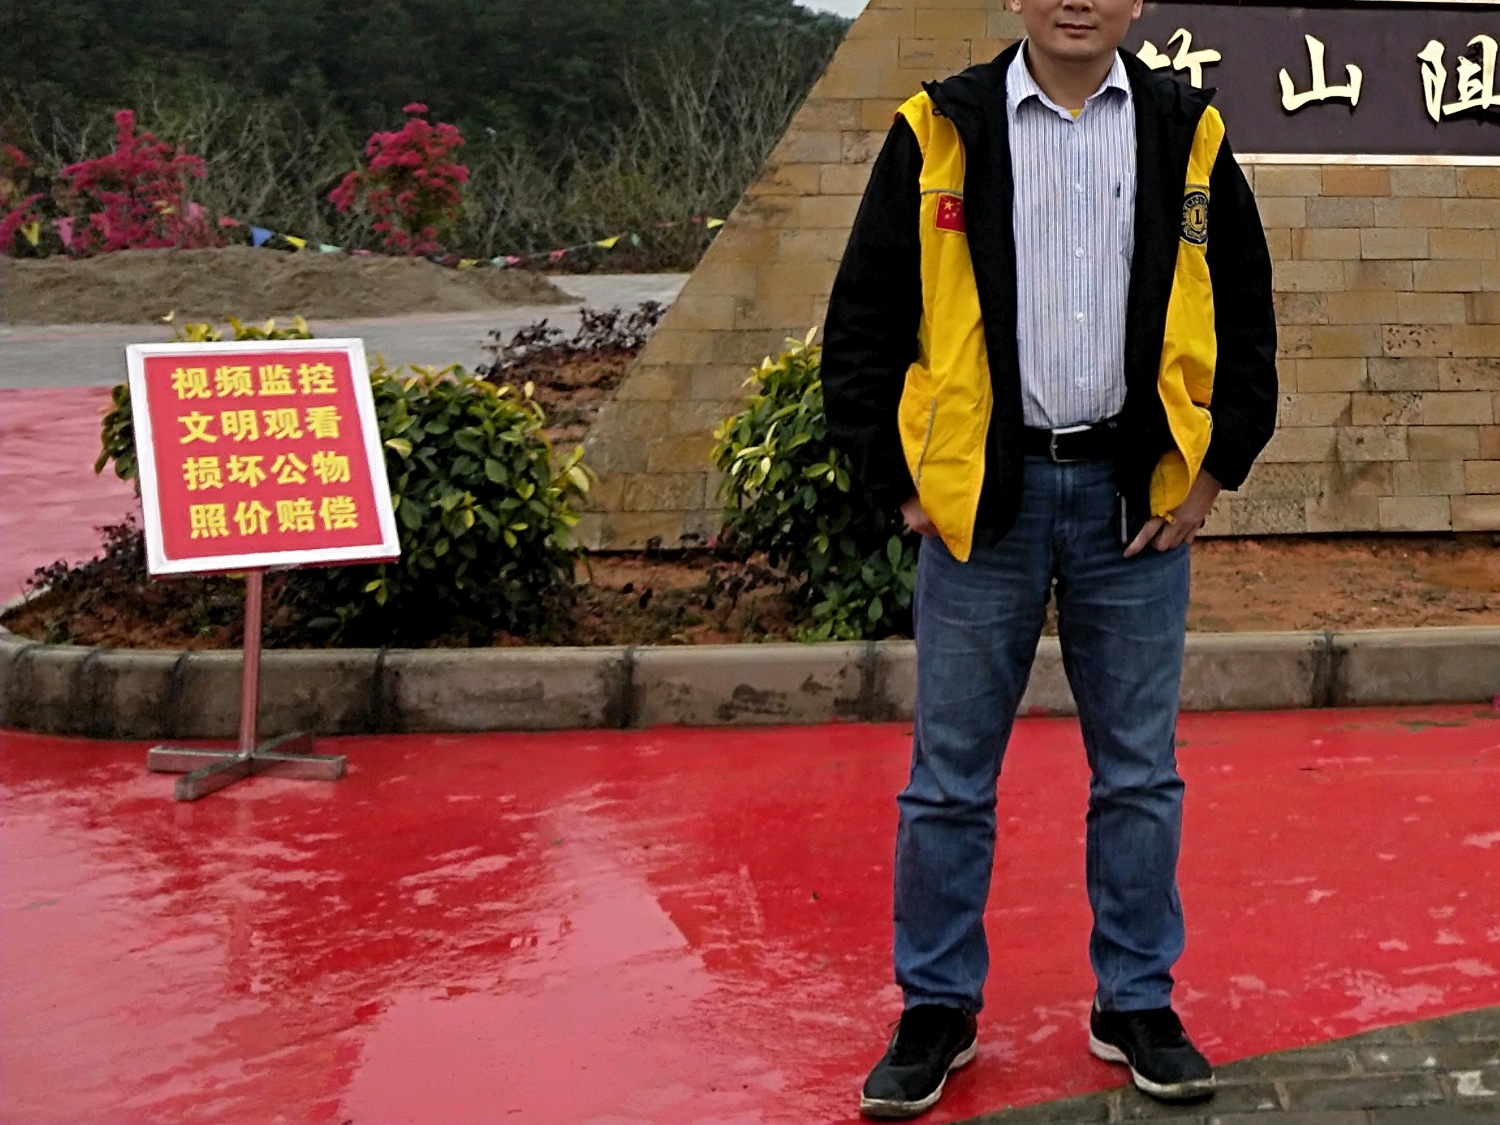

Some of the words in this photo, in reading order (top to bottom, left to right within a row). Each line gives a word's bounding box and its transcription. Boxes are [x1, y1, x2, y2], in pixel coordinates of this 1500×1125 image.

[171, 362, 338, 400] 视频监控
[177, 405, 342, 445] 文明观看
[182, 450, 351, 491] 损坏公物
[190, 495, 359, 539] 照价赔偿
